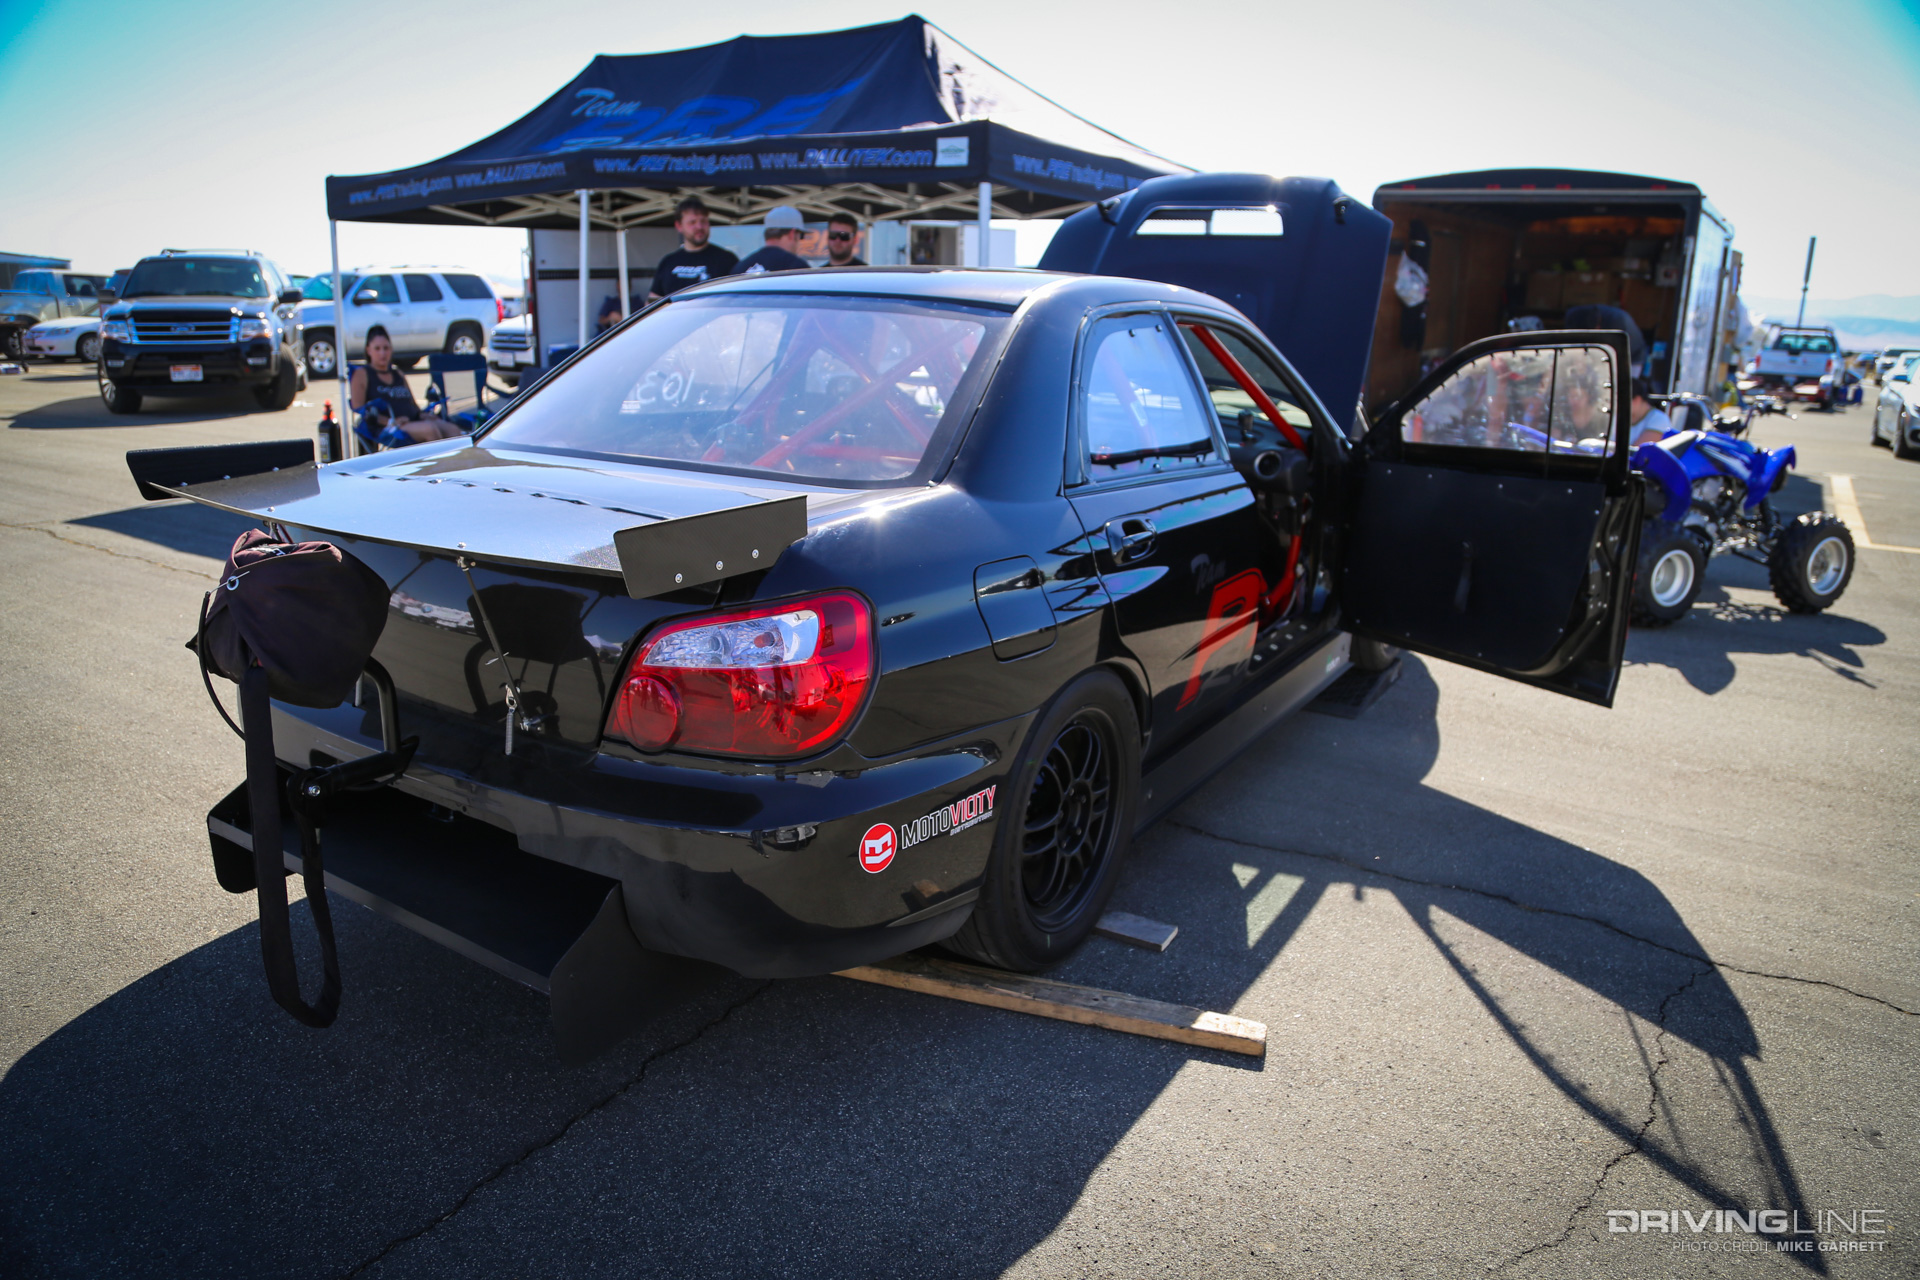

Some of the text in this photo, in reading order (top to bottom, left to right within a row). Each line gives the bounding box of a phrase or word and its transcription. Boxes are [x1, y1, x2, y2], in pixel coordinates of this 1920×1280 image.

[572, 88, 641, 117] Team
[757, 146, 933, 169] www.RALLITEK.com
[901, 784, 997, 850] MOTOVICITY
